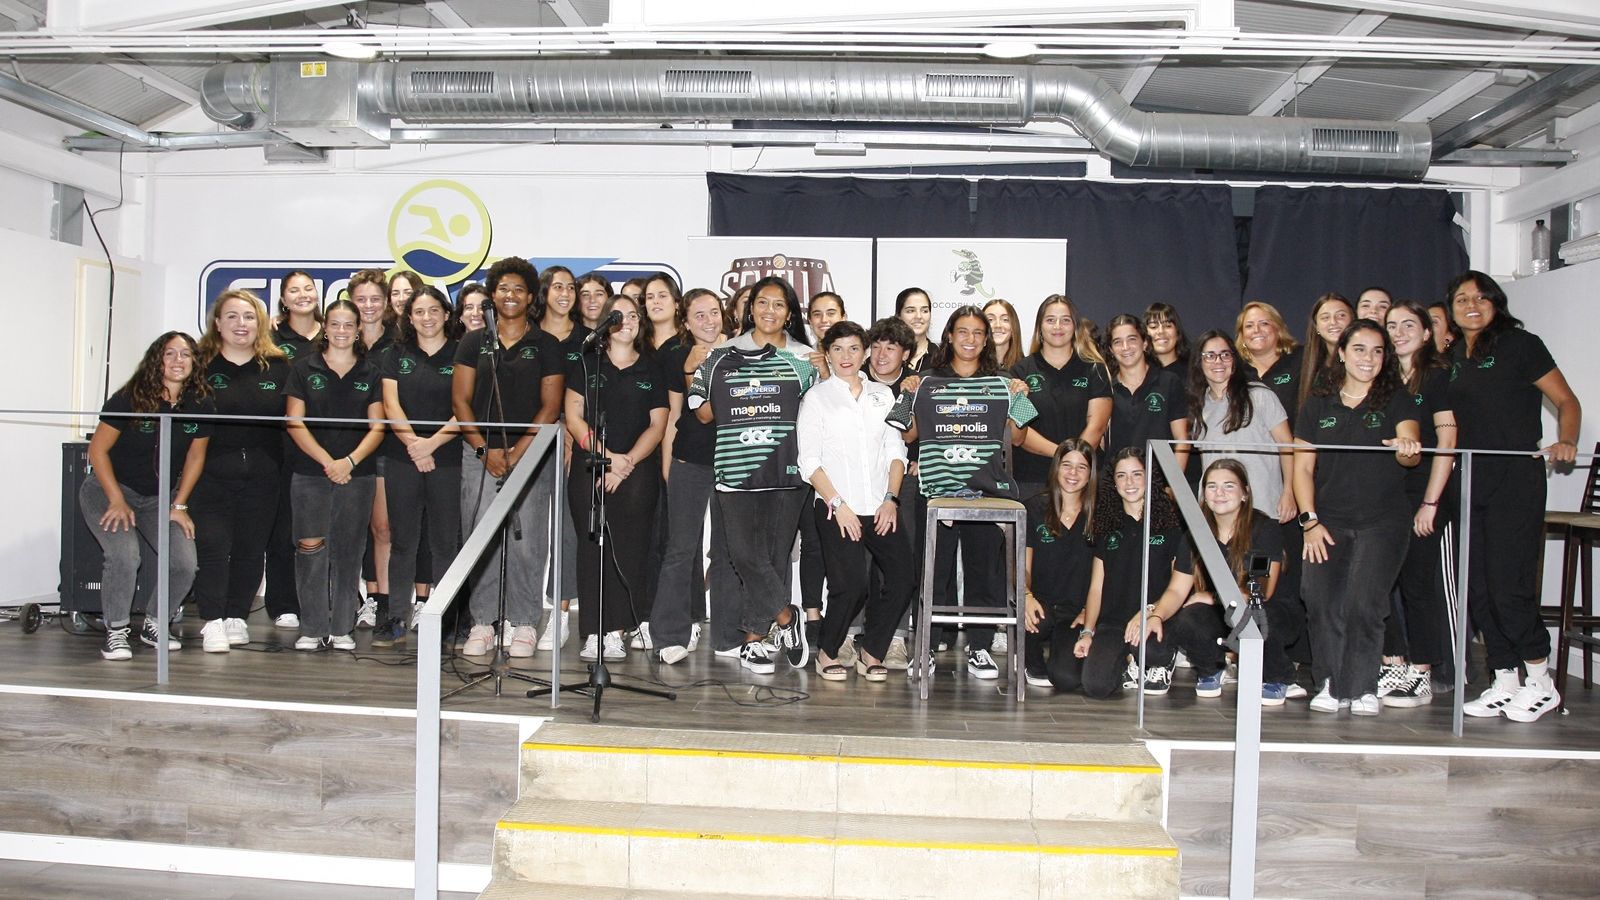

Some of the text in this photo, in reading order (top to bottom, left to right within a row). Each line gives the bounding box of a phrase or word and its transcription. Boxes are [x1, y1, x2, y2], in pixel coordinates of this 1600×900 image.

[788, 260, 823, 269] CESTO
[731, 403, 781, 416] magnolia
[935, 421, 988, 434] magnolia
